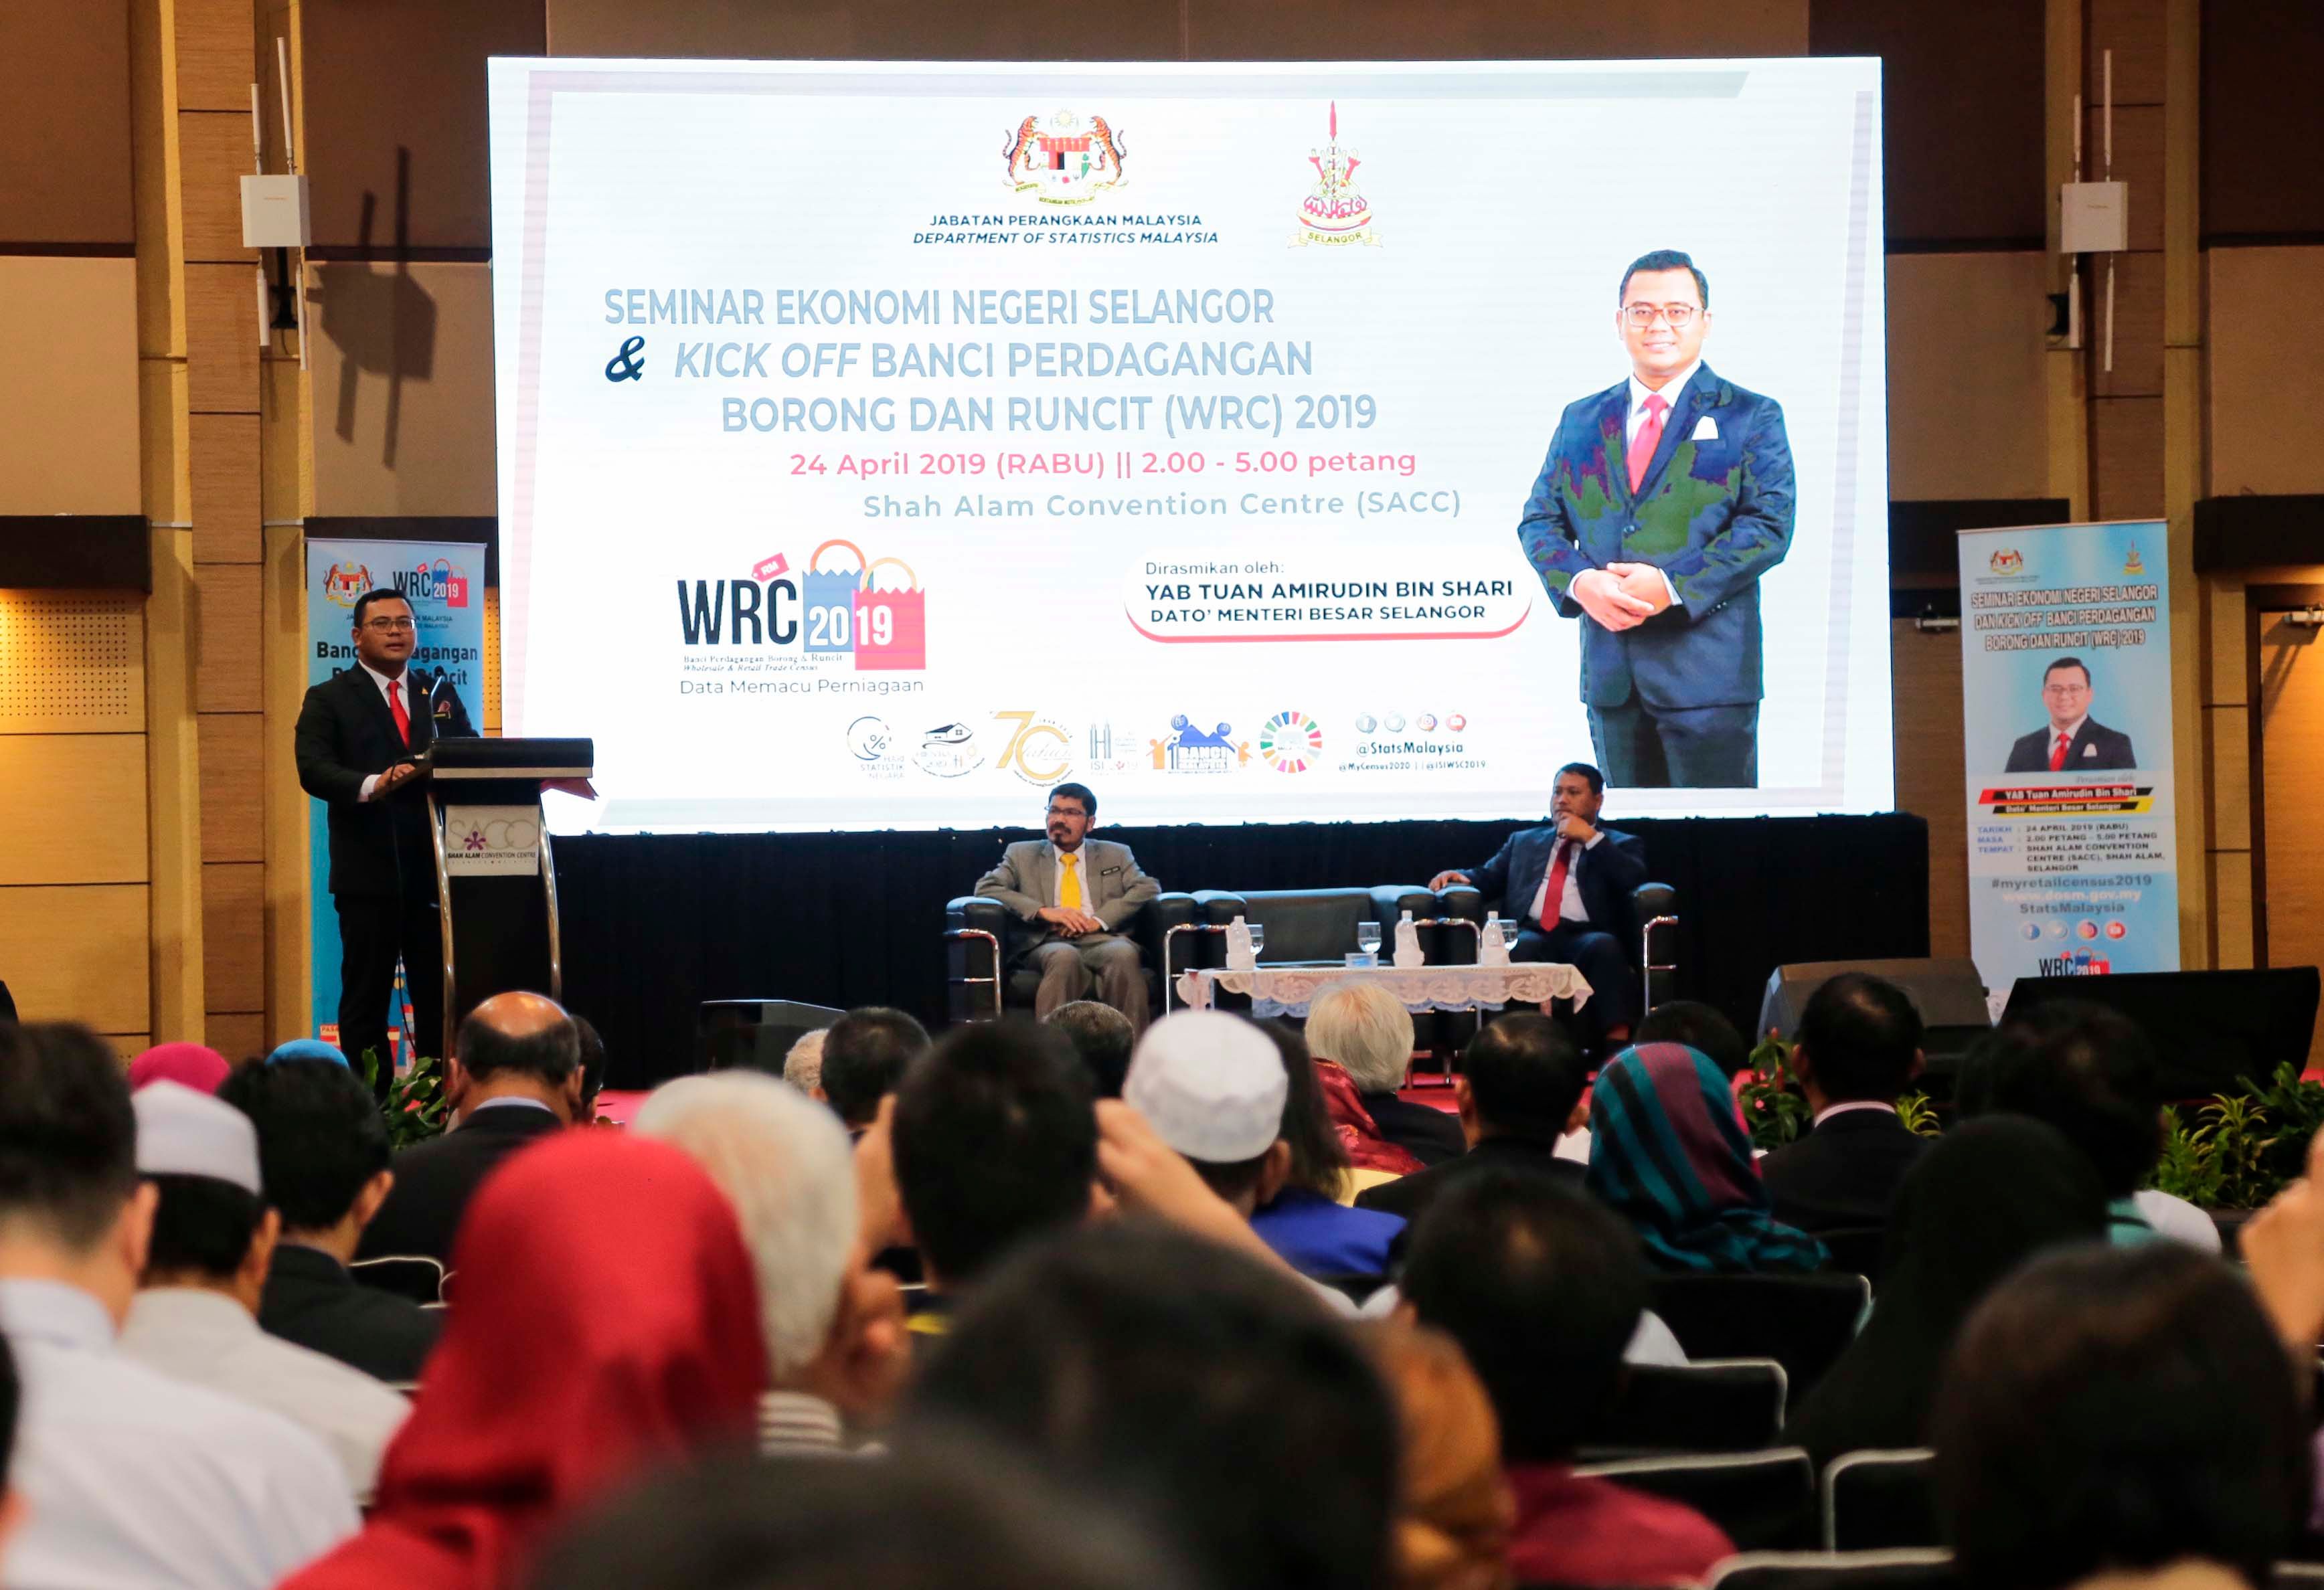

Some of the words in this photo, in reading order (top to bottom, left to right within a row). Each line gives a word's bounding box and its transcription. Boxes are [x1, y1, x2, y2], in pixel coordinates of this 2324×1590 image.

[930, 215, 1003, 226] JABATAN
[1009, 215, 1116, 226] PERANGKAAN
[1123, 215, 1201, 226] MALAYSIA
[914, 233, 1019, 244] DEPARTMENT
[1023, 233, 1044, 243] OF
[1049, 233, 1135, 244] STATISTICS
[1140, 232, 1218, 243] MALAYSIA
[1307, 232, 1363, 244] SELANGOR
[605, 289, 764, 325] SEMINAR
[776, 289, 940, 325] EKONOMI
[953, 289, 1077, 325] NEGERI
[1089, 288, 1274, 324] SELANGOR
[605, 336, 645, 382] &
[675, 343, 771, 377] KICK
[782, 343, 861, 377] OFF
[873, 343, 993, 377] BANCI
[1009, 341, 1312, 377] PERDAGANGAN
[722, 397, 895, 432] BORONG
[910, 397, 993, 432] DAN
[1009, 396, 1153, 431] RUNCIT
[1165, 393, 1282, 438] (WRC)
[1295, 394, 1376, 429] 2019
[791, 454, 827, 474] 24
[837, 452, 908, 480] April
[920, 453, 985, 474] 2019
[997, 452, 1104, 479] (RABU)
[1142, 452, 1205, 473] 2.00
[1236, 451, 1297, 472] 5.00
[1309, 452, 1415, 477] petang
[864, 495, 940, 517] Shah
[954, 494, 1033, 517] Alam
[1048, 492, 1226, 516] Convention
[1240, 493, 1344, 514] Centre
[1357, 490, 1460, 519] (SACC)
[1147, 562, 1238, 575] Dirasmikan
[1244, 561, 1284, 573] oleh:
[393, 571, 431, 597] WRC
[433, 582, 459, 598] 2019
[1146, 585, 1191, 600] YAB
[1199, 584, 1262, 600] TUAN
[1272, 582, 1387, 598] AMIRUDIN
[1396, 582, 1433, 597] BIN
[1442, 581, 1511, 596] SHARI
[1971, 592, 2015, 608] SEMINAR
[2015, 590, 2063, 606] EKONOMI
[2064, 588, 2101, 605] NEGERI
[2102, 584, 2158, 602] SELANGOR
[677, 580, 797, 645] WRC
[809, 605, 893, 646] 2019
[1151, 609, 1210, 622] DATO'
[1218, 608, 1302, 621] MENTERI
[1310, 607, 1373, 620] BESAR
[1380, 606, 1485, 619] SELANGOR
[1975, 614, 1995, 630] DAN
[1997, 612, 2020, 629] KICK
[2023, 611, 2043, 628] OFF
[2046, 610, 2077, 627] BANCI
[2078, 606, 2156, 625] PERDAGANGAN
[1985, 634, 2029, 651] BORONG
[2029, 633, 2051, 649] DAN
[2052, 631, 2088, 648] RUNCIT
[2091, 630, 2121, 648] (WRC)
[2121, 628, 2145, 645] 2019
[681, 681, 723, 694] Data
[731, 681, 811, 693] Memacu
[818, 678, 923, 695] Perniagaan
[1357, 741, 1463, 756] @StatsMalaysia
[2005, 790, 2025, 799] YAB
[2025, 790, 2049, 799] Tuan
[2050, 789, 2094, 798] Amirudin
[2095, 788, 2111, 797] Bin
[2112, 788, 2137, 796] Shari
[2096, 823, 2129, 831] (RABU)
[1992, 875, 2152, 891] #myretailcensus2019
[2020, 903, 2125, 915] StatsMalaysia
[2039, 958, 2074, 976] WRC
